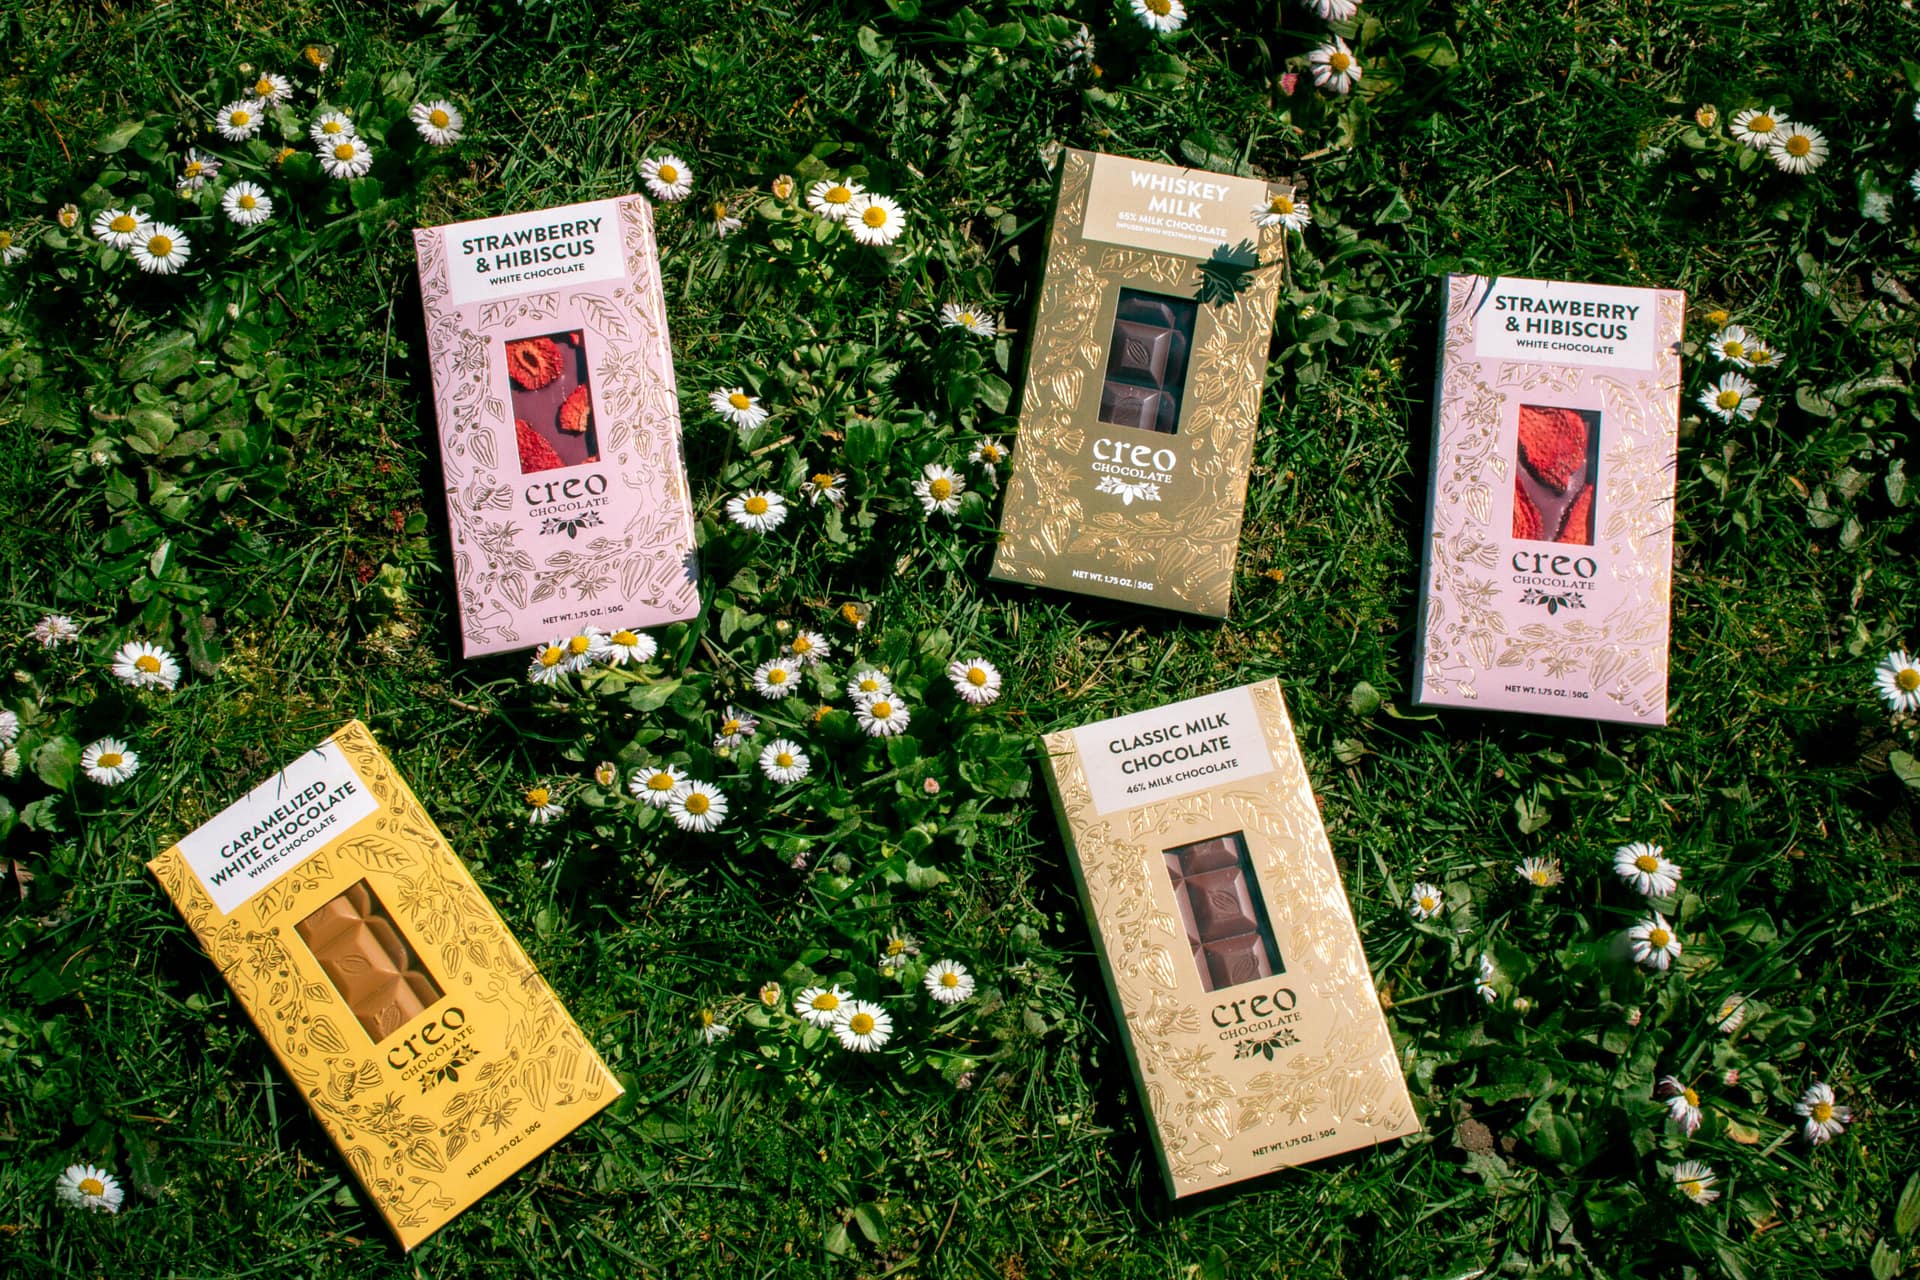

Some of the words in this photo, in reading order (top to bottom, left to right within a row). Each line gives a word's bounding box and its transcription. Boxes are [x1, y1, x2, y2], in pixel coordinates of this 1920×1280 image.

[1130, 170, 1230, 202] WHISKEY
[1148, 195, 1204, 219] MILK
[463, 217, 603, 255] STRAWBERRY
[1138, 214, 1163, 226] MILK
[1166, 219, 1228, 237] CHOCOLATE
[476, 257, 491, 273] &
[496, 239, 595, 270] HIBISCUS
[489, 274, 521, 286] WHITE
[523, 263, 585, 281] CHOCOLATE
[1495, 295, 1640, 321] STRAWBERRY
[1505, 316, 1520, 332] &
[1526, 317, 1628, 340] HIBISCUS
[1517, 340, 1549, 349] WHITE
[1552, 343, 1614, 354] CHOCOLATE
[1093, 438, 1176, 471] creo
[1092, 462, 1173, 483] CHOCOLATE
[525, 474, 607, 505] creo
[529, 497, 609, 517] CHOCOLATE
[1072, 570, 1089, 579] NET
[1090, 572, 1103, 581] WT.
[1104, 576, 1118, 584] 1.75
[1120, 579, 1132, 587] OZ.
[1137, 581, 1153, 590] 50G
[1512, 552, 1597, 578] creo
[1513, 575, 1595, 590] CHOCOLATE
[542, 616, 558, 624] NET
[575, 611, 588, 619] 1.75
[608, 605, 623, 613] 50G
[1523, 686, 1536, 694] WT.
[1572, 691, 1588, 699] 50G
[1109, 725, 1181, 754] CLASSIC
[1185, 713, 1230, 736] MILK
[1121, 736, 1231, 774] CHOCOLATE
[1126, 782, 1147, 794] 46%
[1148, 775, 1174, 788] MILK
[1175, 759, 1239, 782] CHOCOLATE
[210, 847, 263, 886] WHITE
[262, 781, 357, 850] CHOCOLATE
[221, 781, 326, 859] CARAMELIZED
[248, 854, 280, 879] WHITE
[280, 814, 337, 857] CHOCOLATE
[1211, 988, 1297, 1028] creo
[387, 1007, 465, 1070] creo
[1219, 1012, 1302, 1041] CHOCOLATE
[401, 1025, 476, 1081] CHOCOLATE
[467, 1164, 482, 1178] NET
[482, 1155, 496, 1166] WT.
[495, 1144, 510, 1157] 1.75
[510, 1136, 523, 1146] OZ.
[525, 1121, 541, 1135] 50G
[1252, 1146, 1269, 1157] NET
[1270, 1142, 1284, 1151] WT.
[1285, 1138, 1300, 1147] 1.75
[1301, 1134, 1315, 1143] OZ.
[1320, 1128, 1336, 1138] 50G
